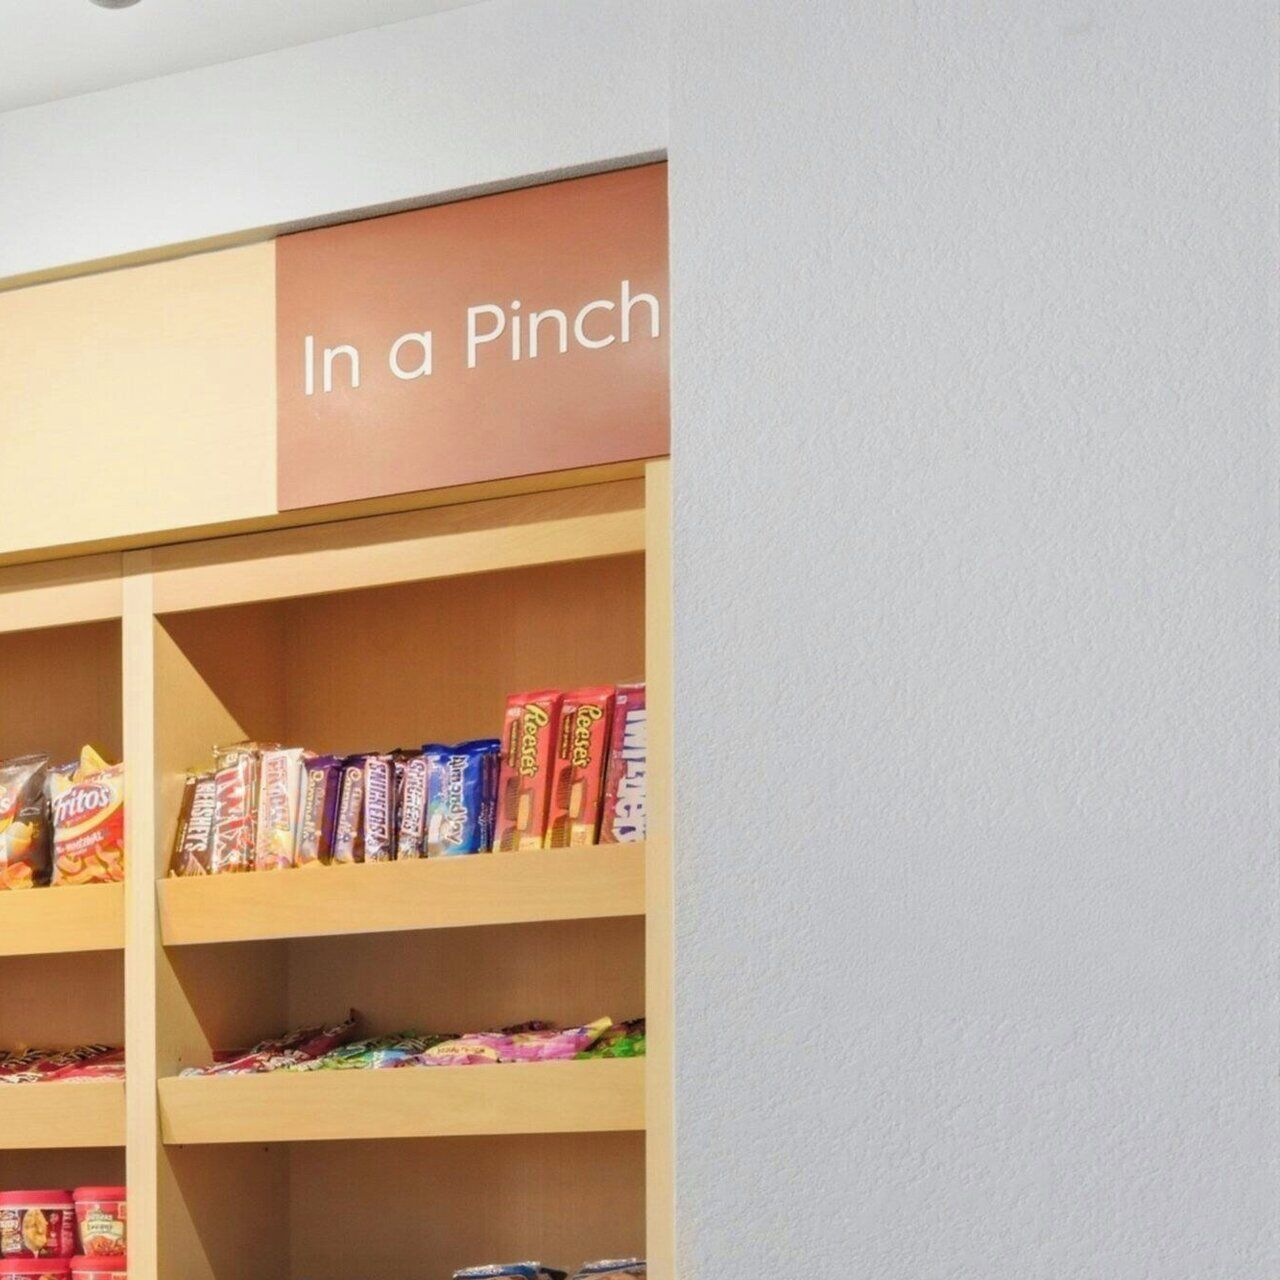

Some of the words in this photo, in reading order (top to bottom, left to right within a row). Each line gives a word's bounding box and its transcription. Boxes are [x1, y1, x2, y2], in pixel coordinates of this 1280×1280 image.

[304, 335, 360, 396] In
[388, 329, 434, 380] a
[466, 279, 661, 369] Pinch
[52, 784, 111, 827] Fritos
